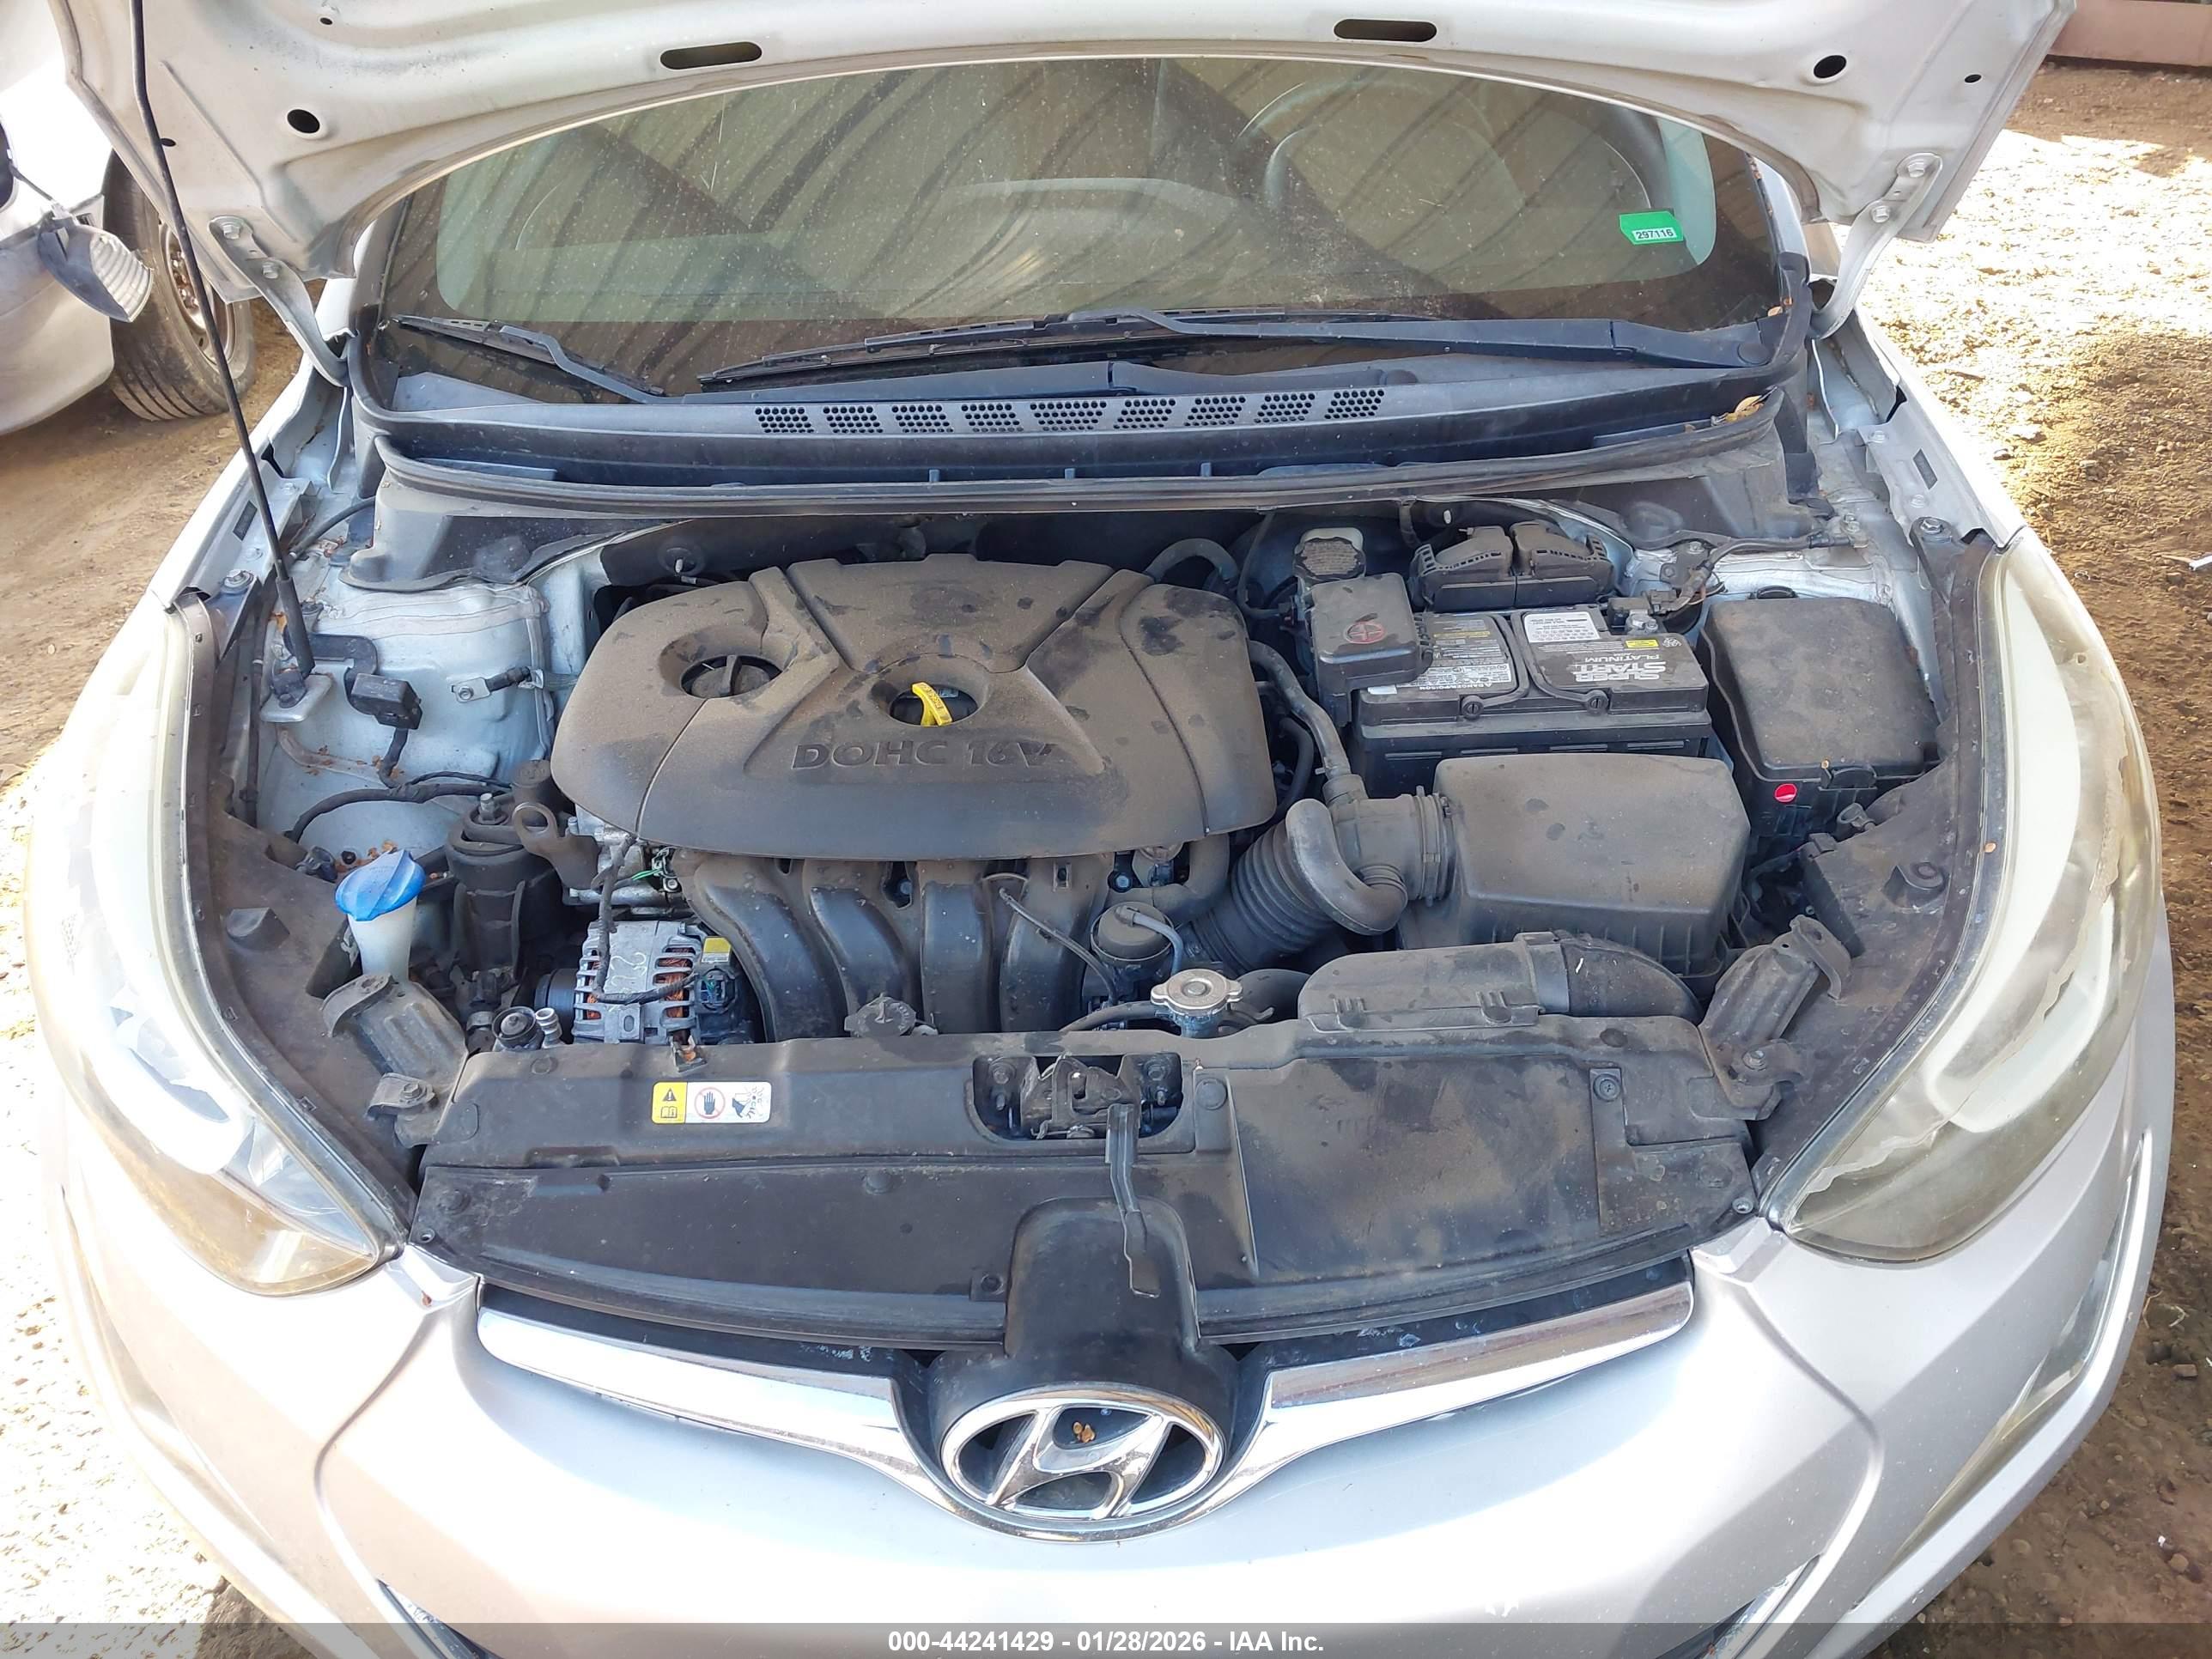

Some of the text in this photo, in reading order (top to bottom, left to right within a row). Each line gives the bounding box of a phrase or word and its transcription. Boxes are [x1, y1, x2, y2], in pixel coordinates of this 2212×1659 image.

[1635, 228, 1674, 240] 297116
[1584, 654, 1660, 663] PLATINUM
[1575, 660, 1667, 673] START
[1575, 671, 1660, 682] SUPER
[791, 739, 1057, 770] DOHC 16V
